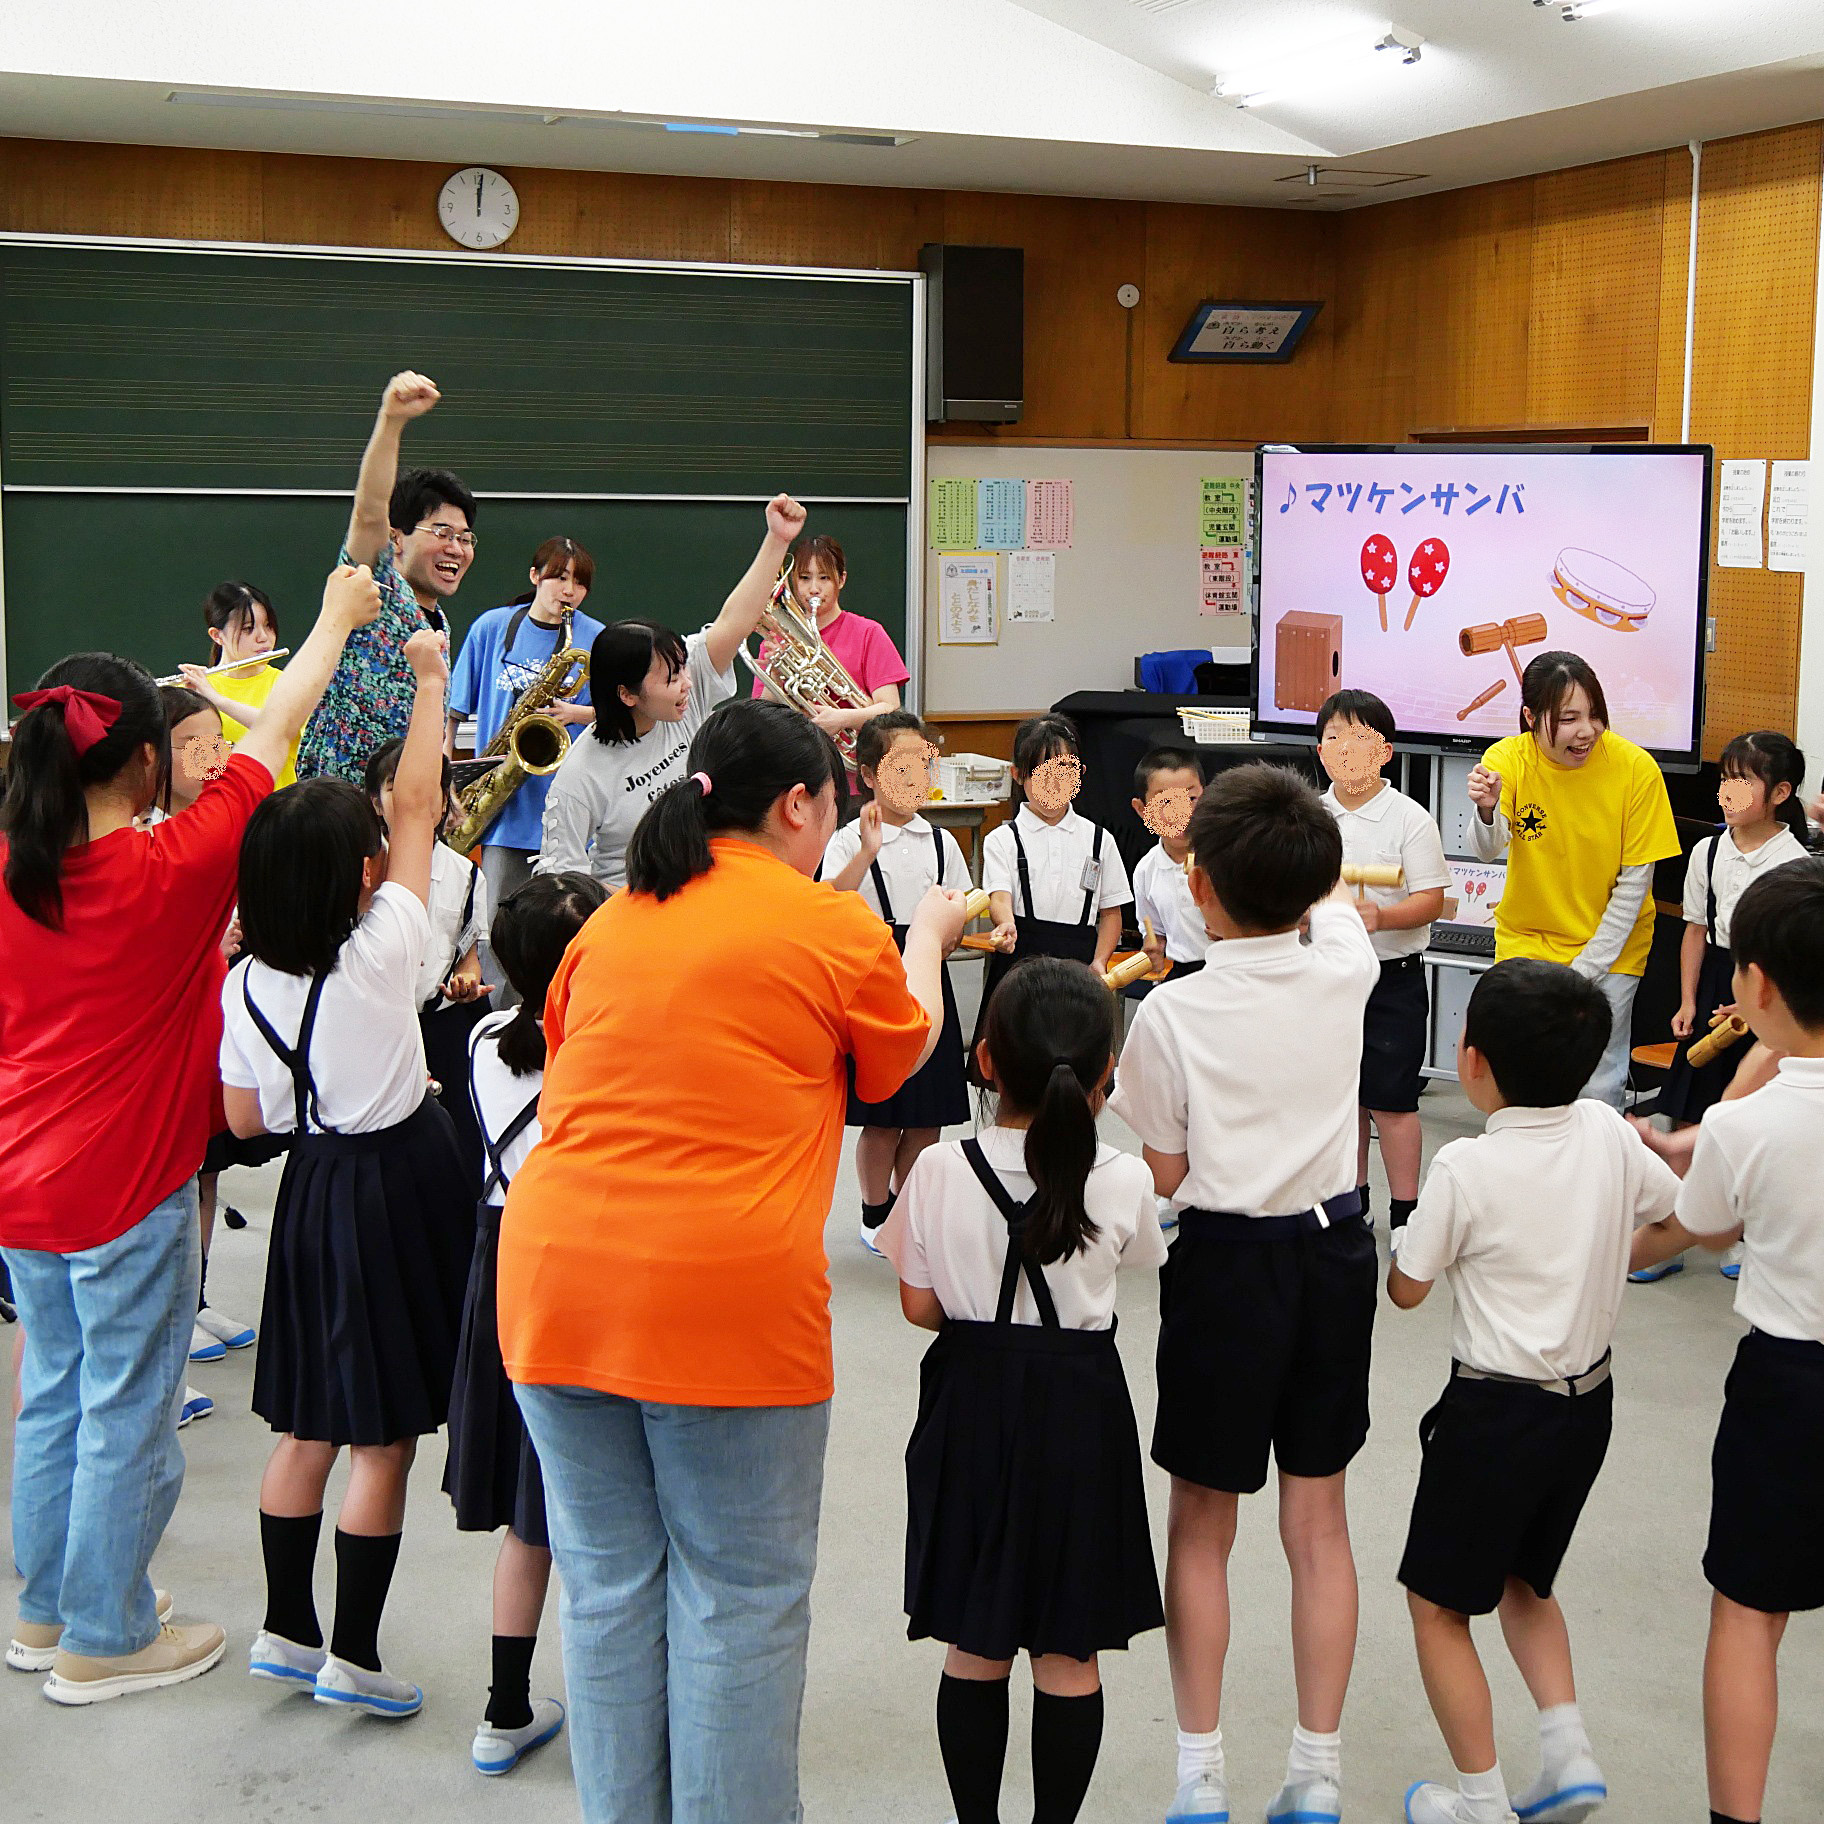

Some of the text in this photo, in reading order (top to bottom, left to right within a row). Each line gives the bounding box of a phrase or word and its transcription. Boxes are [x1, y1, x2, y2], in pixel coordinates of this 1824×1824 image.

[447, 203, 453, 213] 9
[504, 205, 510, 215] 3
[476, 233, 482, 242] 6
[1306, 482, 1524, 516] マツケンサンバ
[625, 742, 688, 792] Joyeuses
[1517, 803, 1547, 818] CONVERSE
[1516, 829, 1543, 841] ALL STAR
